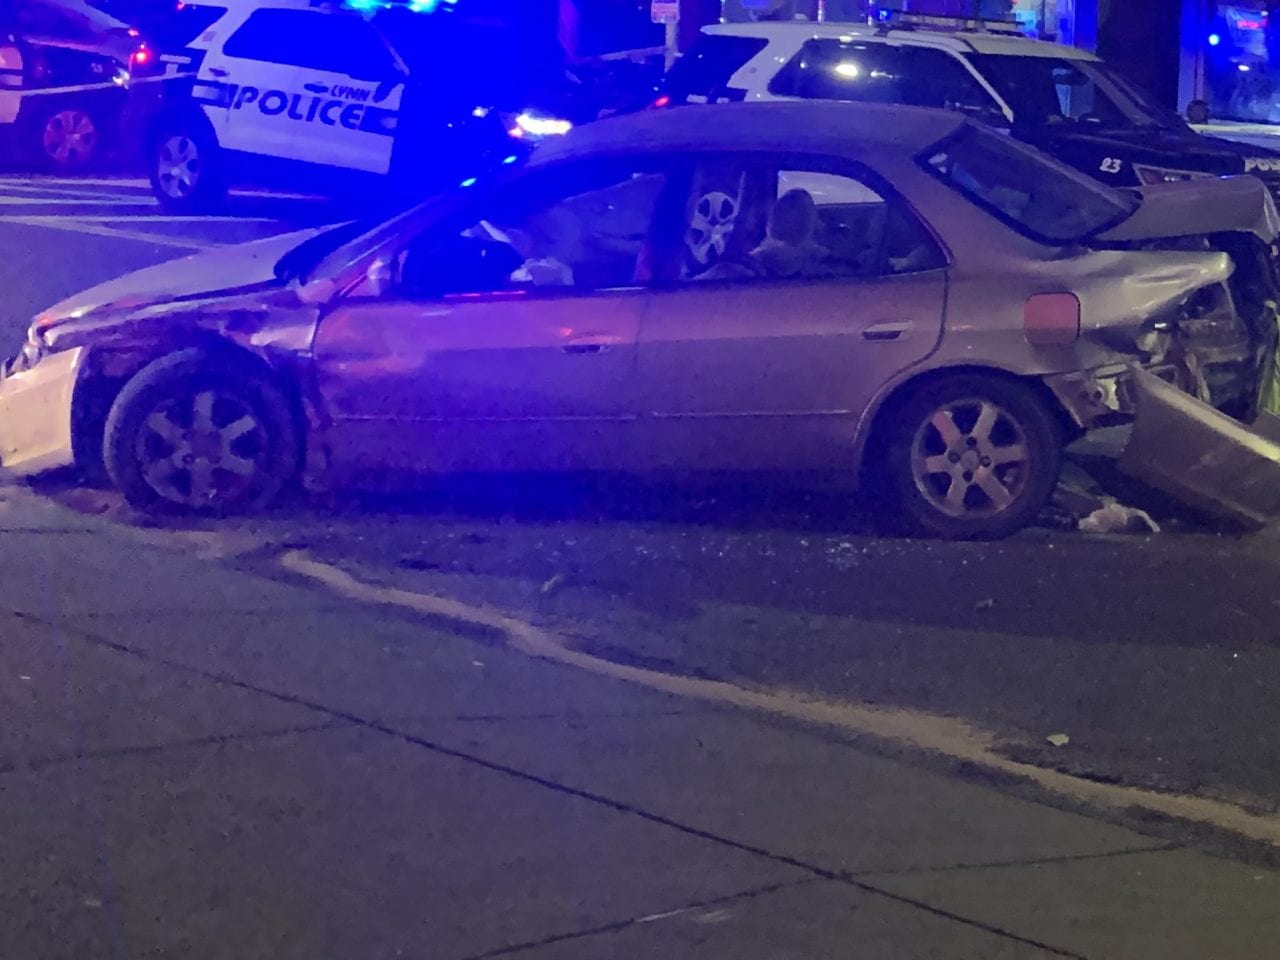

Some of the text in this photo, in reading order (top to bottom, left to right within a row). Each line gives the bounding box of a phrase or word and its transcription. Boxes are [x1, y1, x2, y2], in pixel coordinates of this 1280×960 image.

[331, 84, 371, 102] LYNN
[233, 86, 365, 131] POLICE
[1099, 157, 1122, 174] 23
